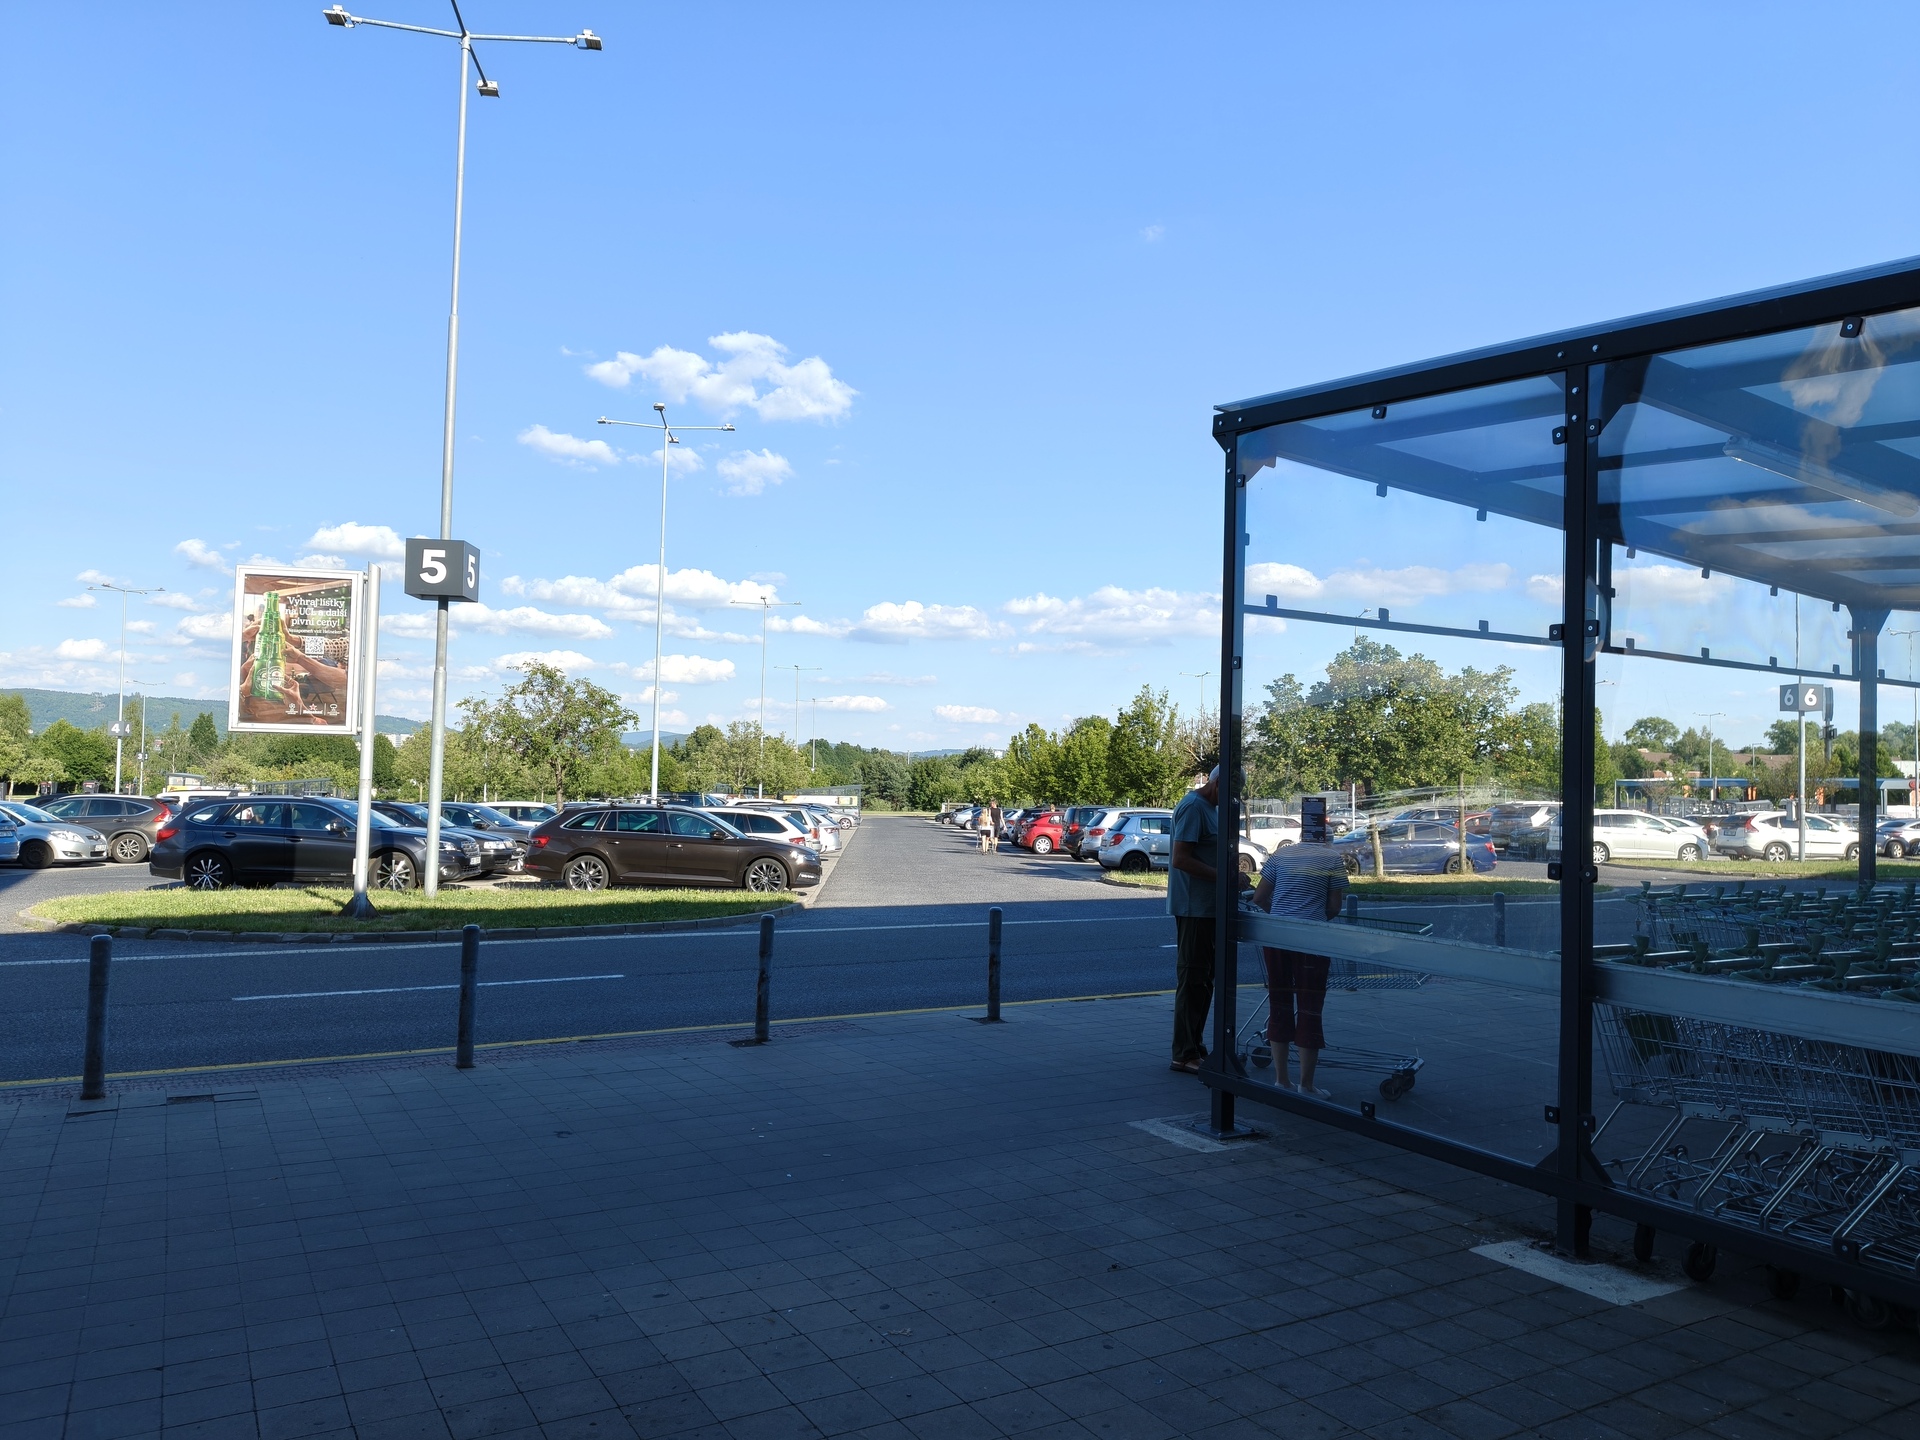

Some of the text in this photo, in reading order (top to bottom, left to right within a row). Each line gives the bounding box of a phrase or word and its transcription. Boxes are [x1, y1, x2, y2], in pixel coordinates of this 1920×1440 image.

[419, 548, 447, 584] 5
[467, 554, 476, 589] 5
[287, 596, 318, 607] Vyhraj
[299, 607, 316, 616] UCL
[291, 617, 314, 626] pivní
[1783, 688, 1794, 706] 6
[1804, 688, 1817, 706] 6
